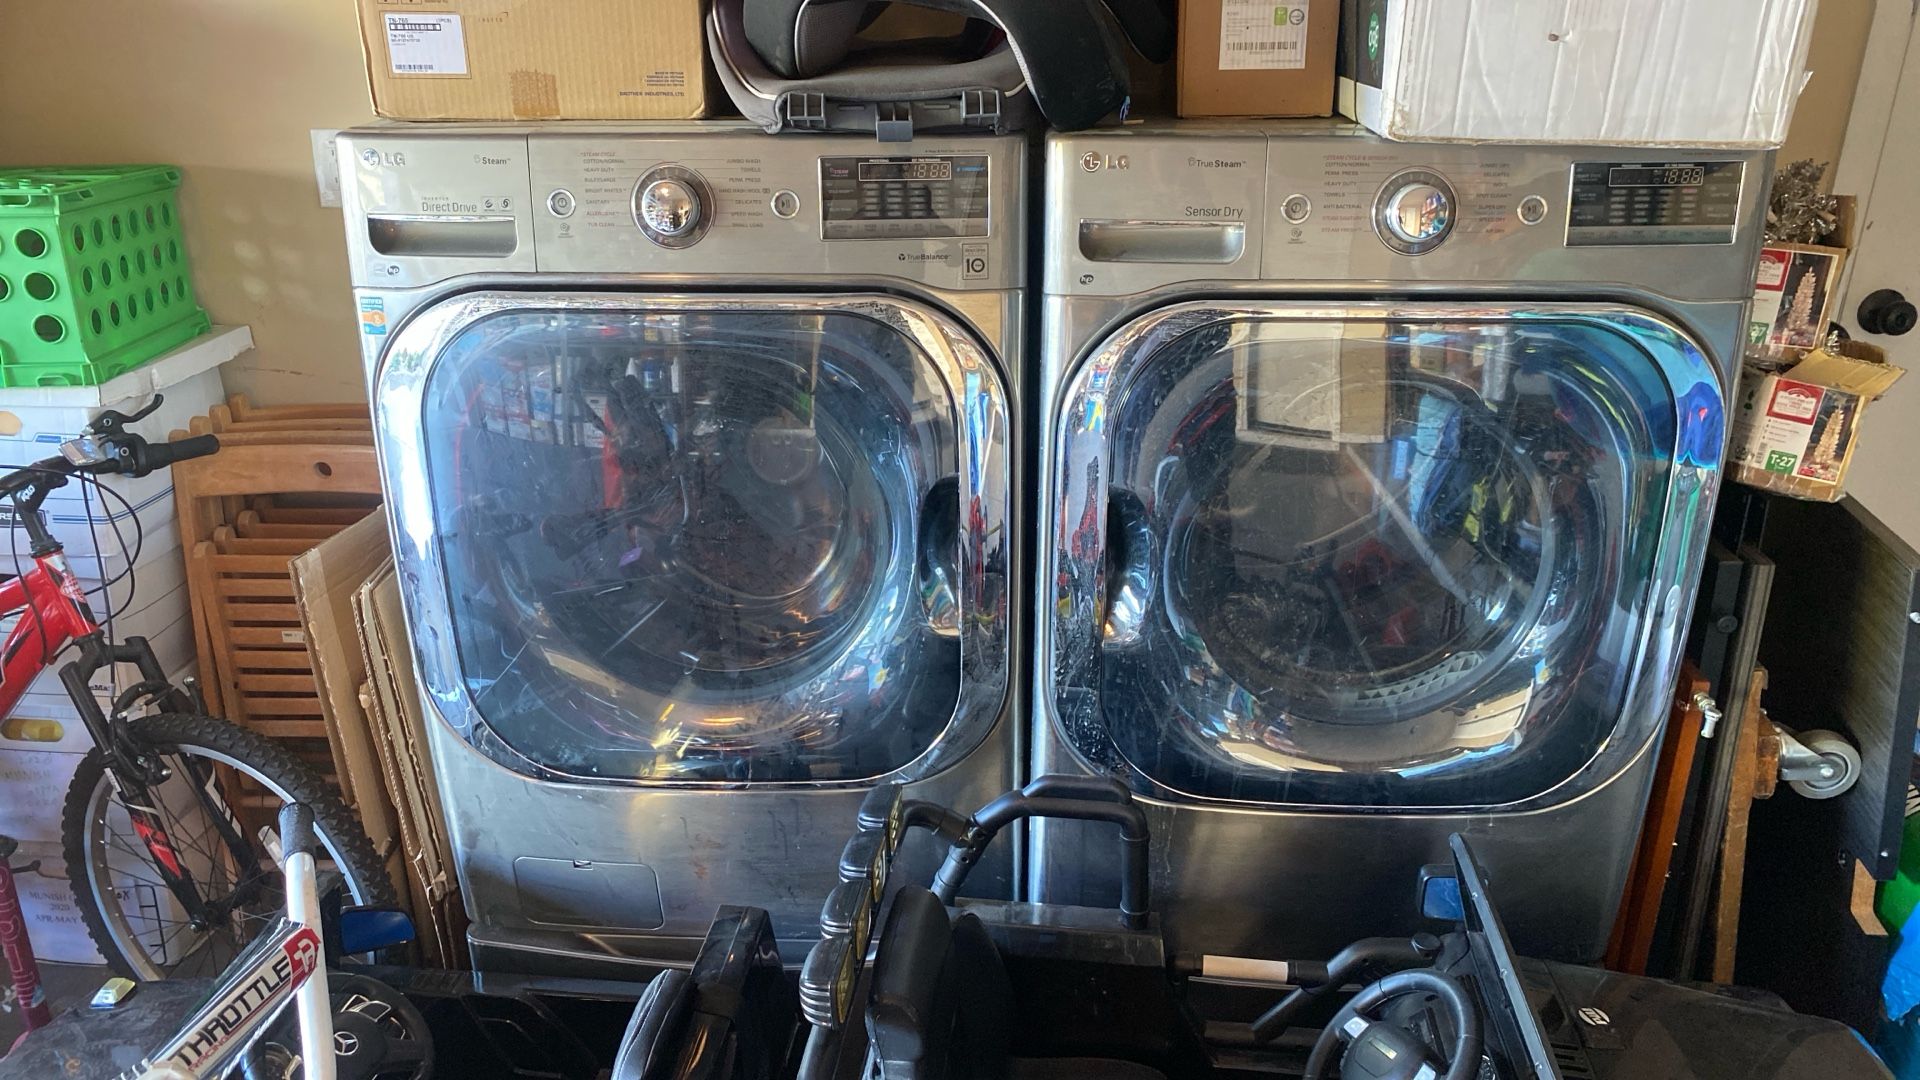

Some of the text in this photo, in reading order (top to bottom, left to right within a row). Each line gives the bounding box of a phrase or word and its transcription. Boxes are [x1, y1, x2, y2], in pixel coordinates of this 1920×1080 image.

[383, 152, 406, 166] LG
[1105, 154, 1131, 170] LG
[422, 202, 477, 212] Direct Drive
[1184, 206, 1244, 219] Sensor Dry
[1770, 454, 1795, 467] T-27
[168, 955, 292, 1067] THROTTLE
